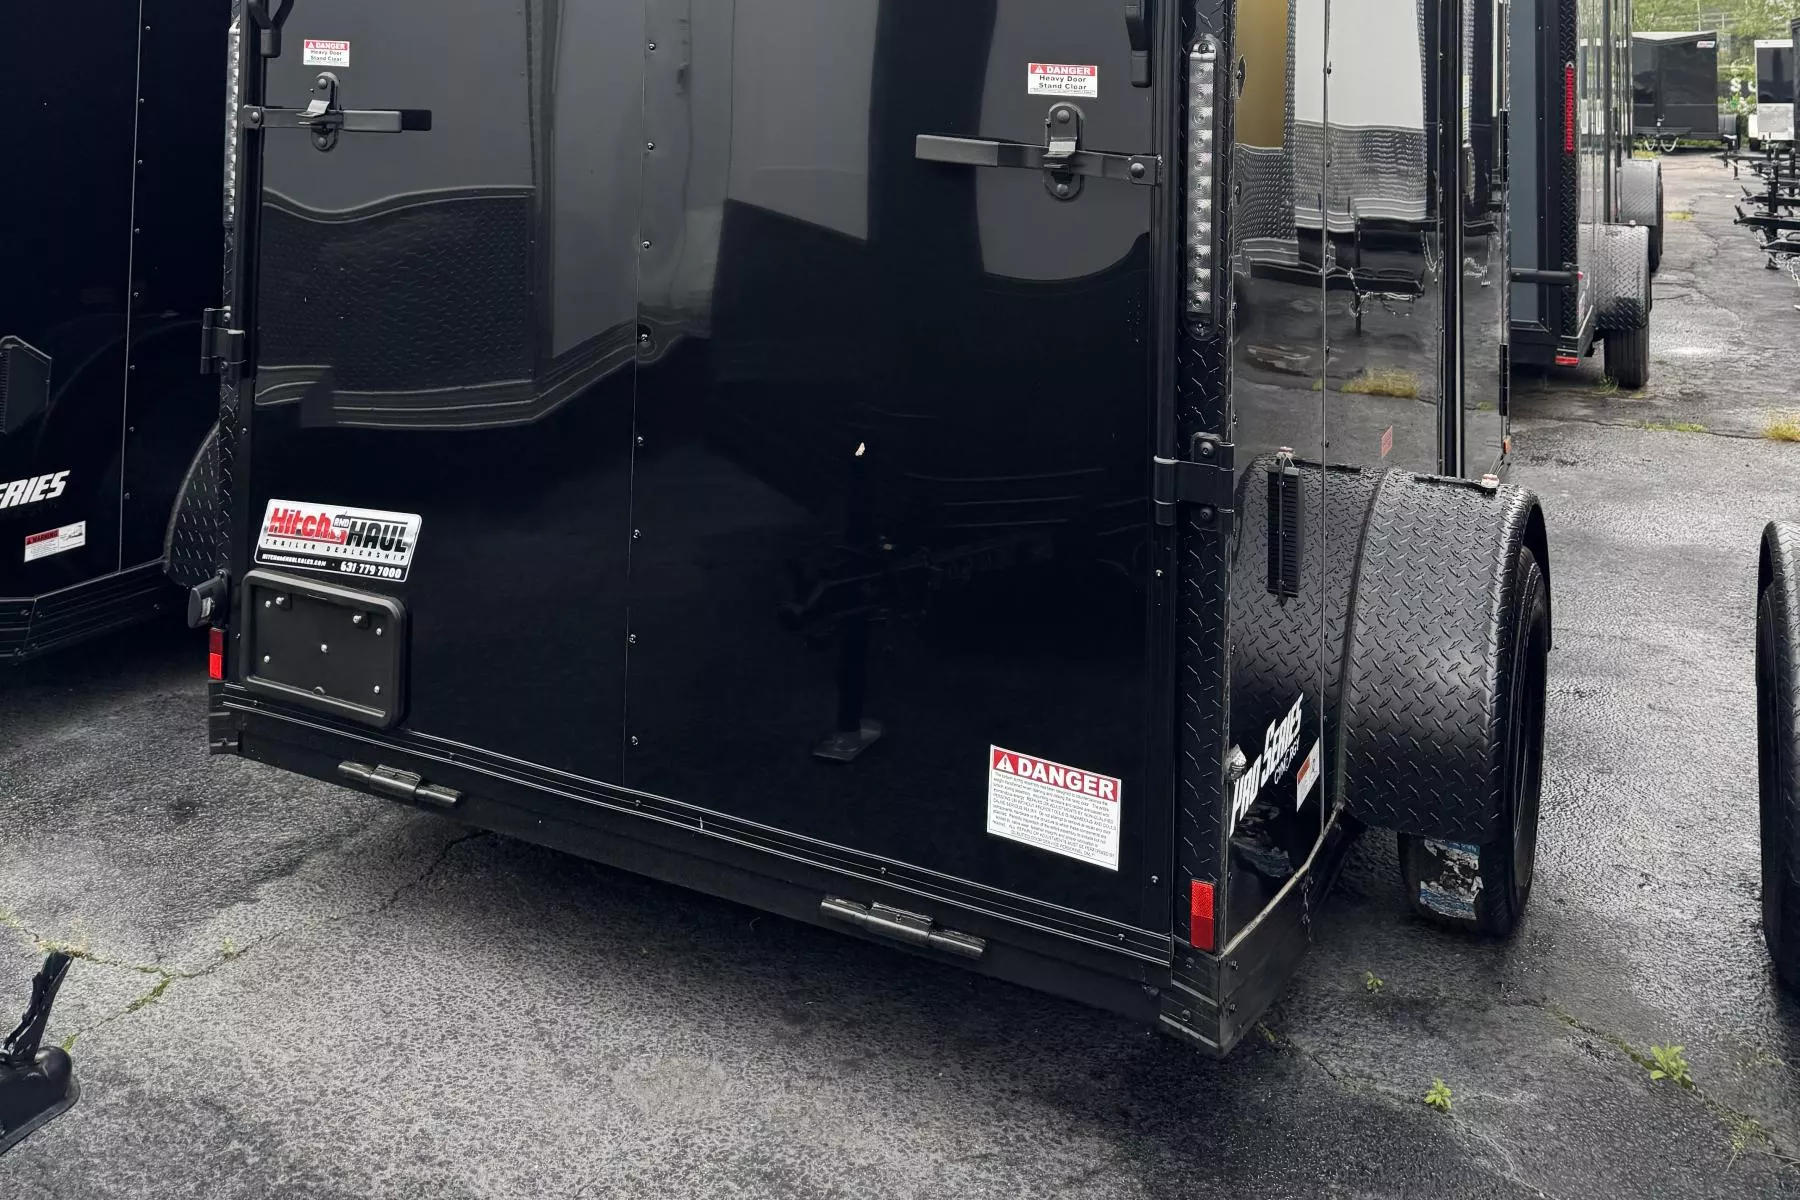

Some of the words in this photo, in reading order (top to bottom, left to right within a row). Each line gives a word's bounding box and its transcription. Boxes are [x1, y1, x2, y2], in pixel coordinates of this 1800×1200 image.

[1046, 66, 1091, 75] DANGER
[268, 507, 332, 539] Hitch
[346, 520, 408, 553] HAUL
[265, 538, 316, 550] TRAILER
[327, 546, 405, 561] DEALERSHIP
[1017, 758, 1115, 801] DANGER
